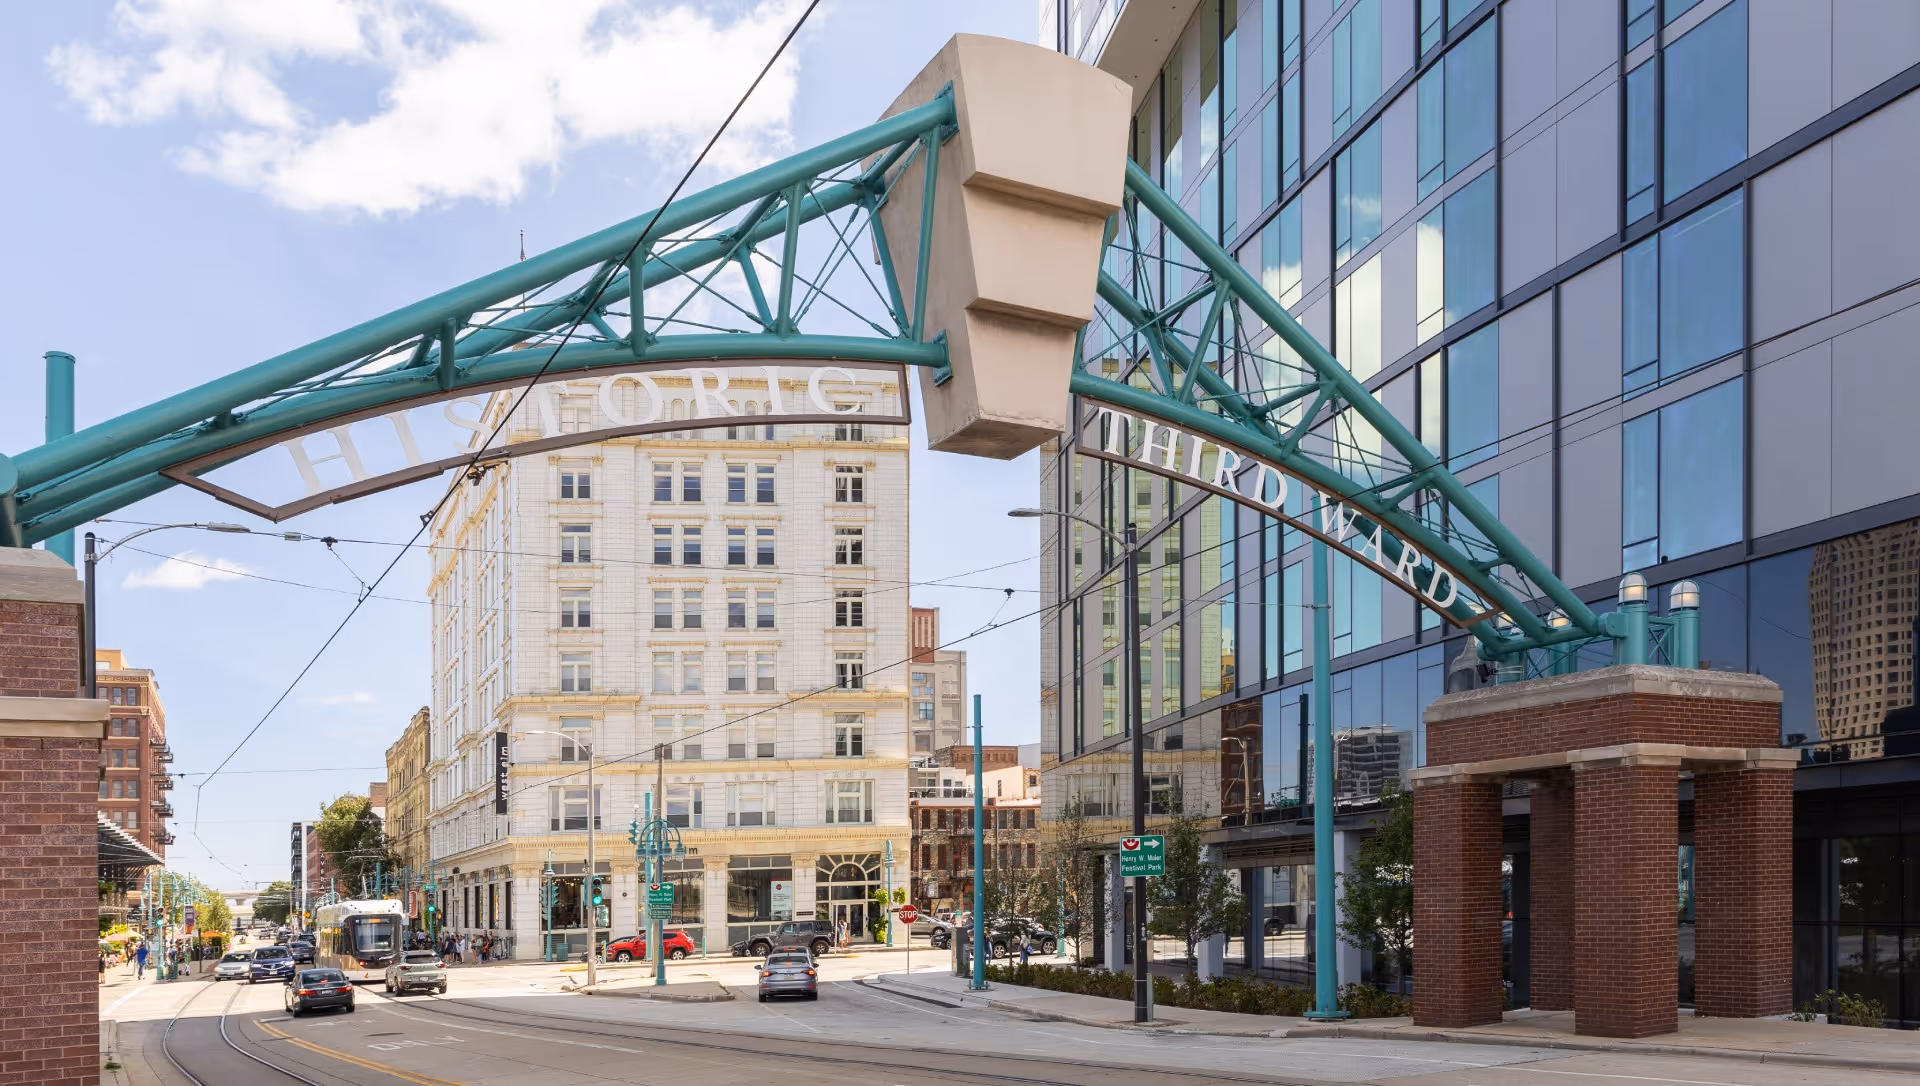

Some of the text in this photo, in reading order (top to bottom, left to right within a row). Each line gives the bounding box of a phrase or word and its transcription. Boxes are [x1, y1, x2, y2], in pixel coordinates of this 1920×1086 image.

[279, 365, 861, 491] HISTORIC
[1098, 406, 1458, 609] THIRD WARD
[500, 746, 508, 800] west elm
[900, 910, 917, 918] STOP
